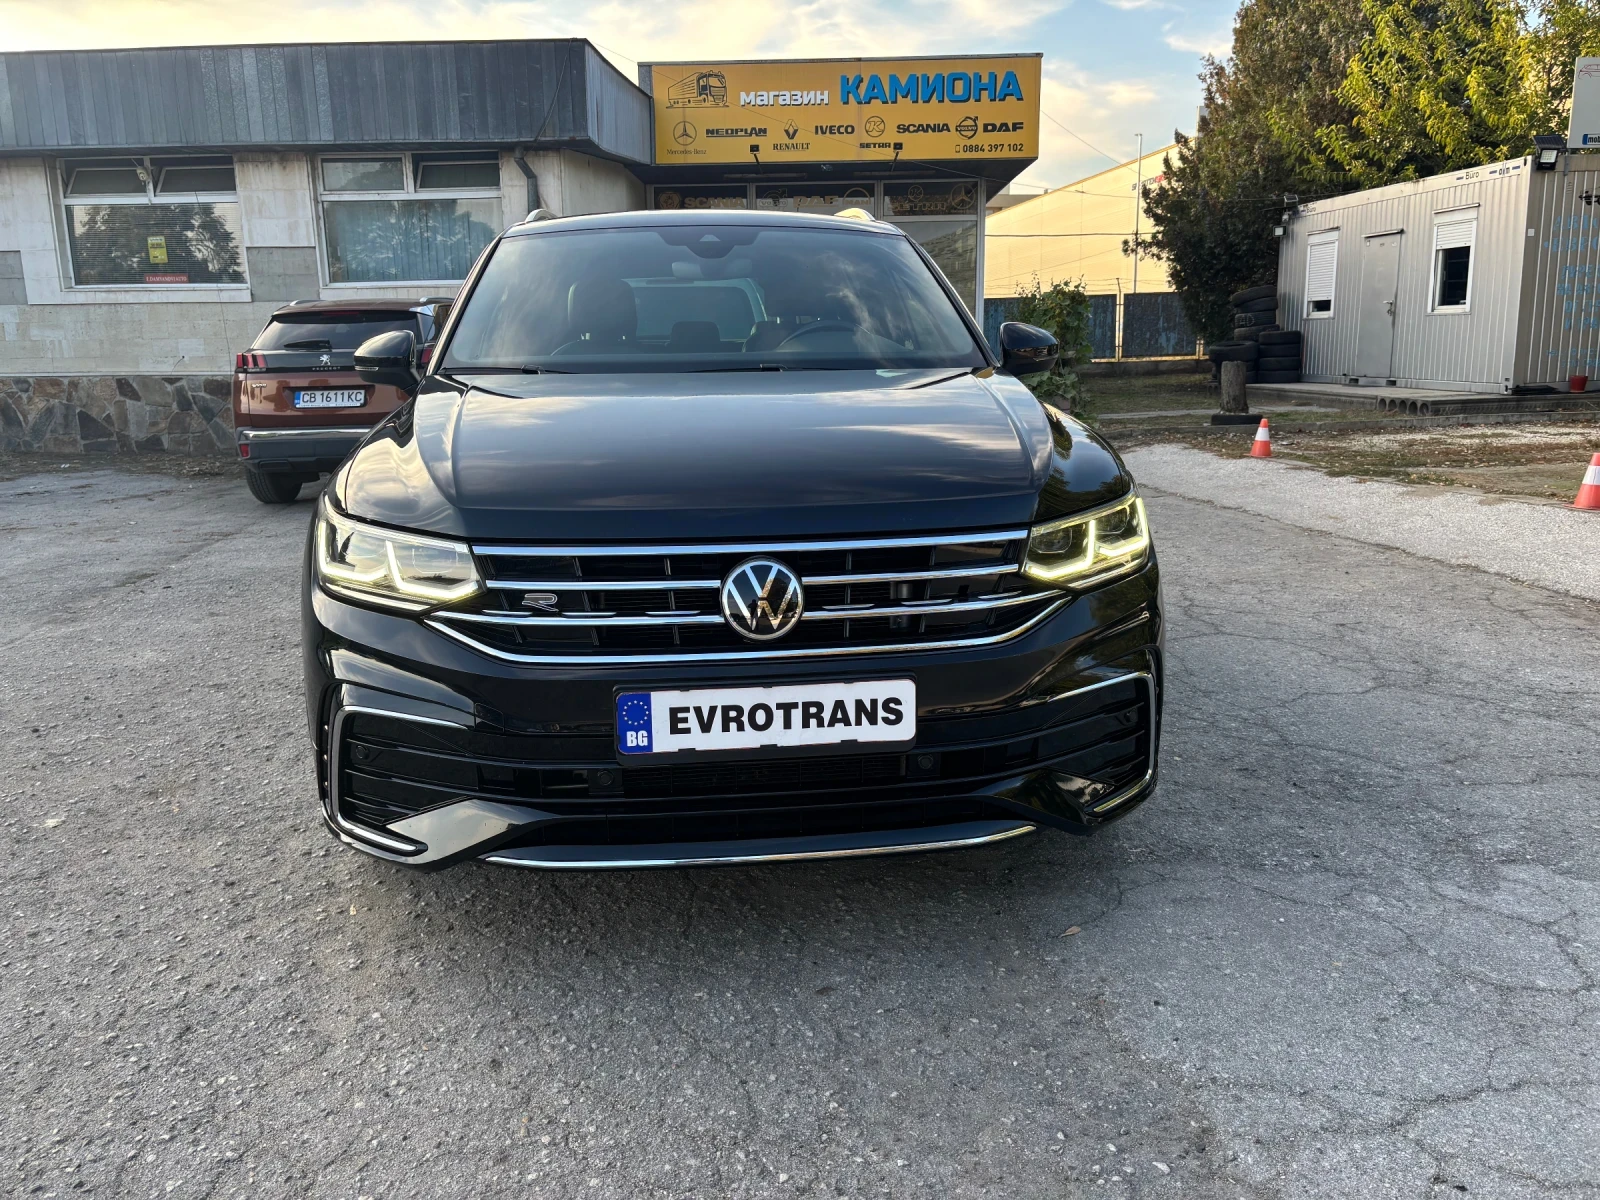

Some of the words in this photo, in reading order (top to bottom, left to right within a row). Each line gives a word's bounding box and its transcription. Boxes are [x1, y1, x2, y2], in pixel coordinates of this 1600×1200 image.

[740, 90, 829, 106] магазин
[840, 71, 1024, 105] КАМИОНА
[706, 127, 767, 137] NEOPLAN
[815, 124, 855, 135] IVECO
[896, 123, 951, 133] SCANIA
[983, 122, 1024, 133] DAF
[773, 143, 810, 151] RENAULT
[963, 144, 985, 153] 0884
[988, 144, 1005, 152] 397
[1008, 143, 1024, 152] 102
[684, 197, 746, 208] SCANIA
[302, 392, 317, 403] CB
[668, 697, 904, 735] EVROTRANS
[626, 730, 648, 747] BG
